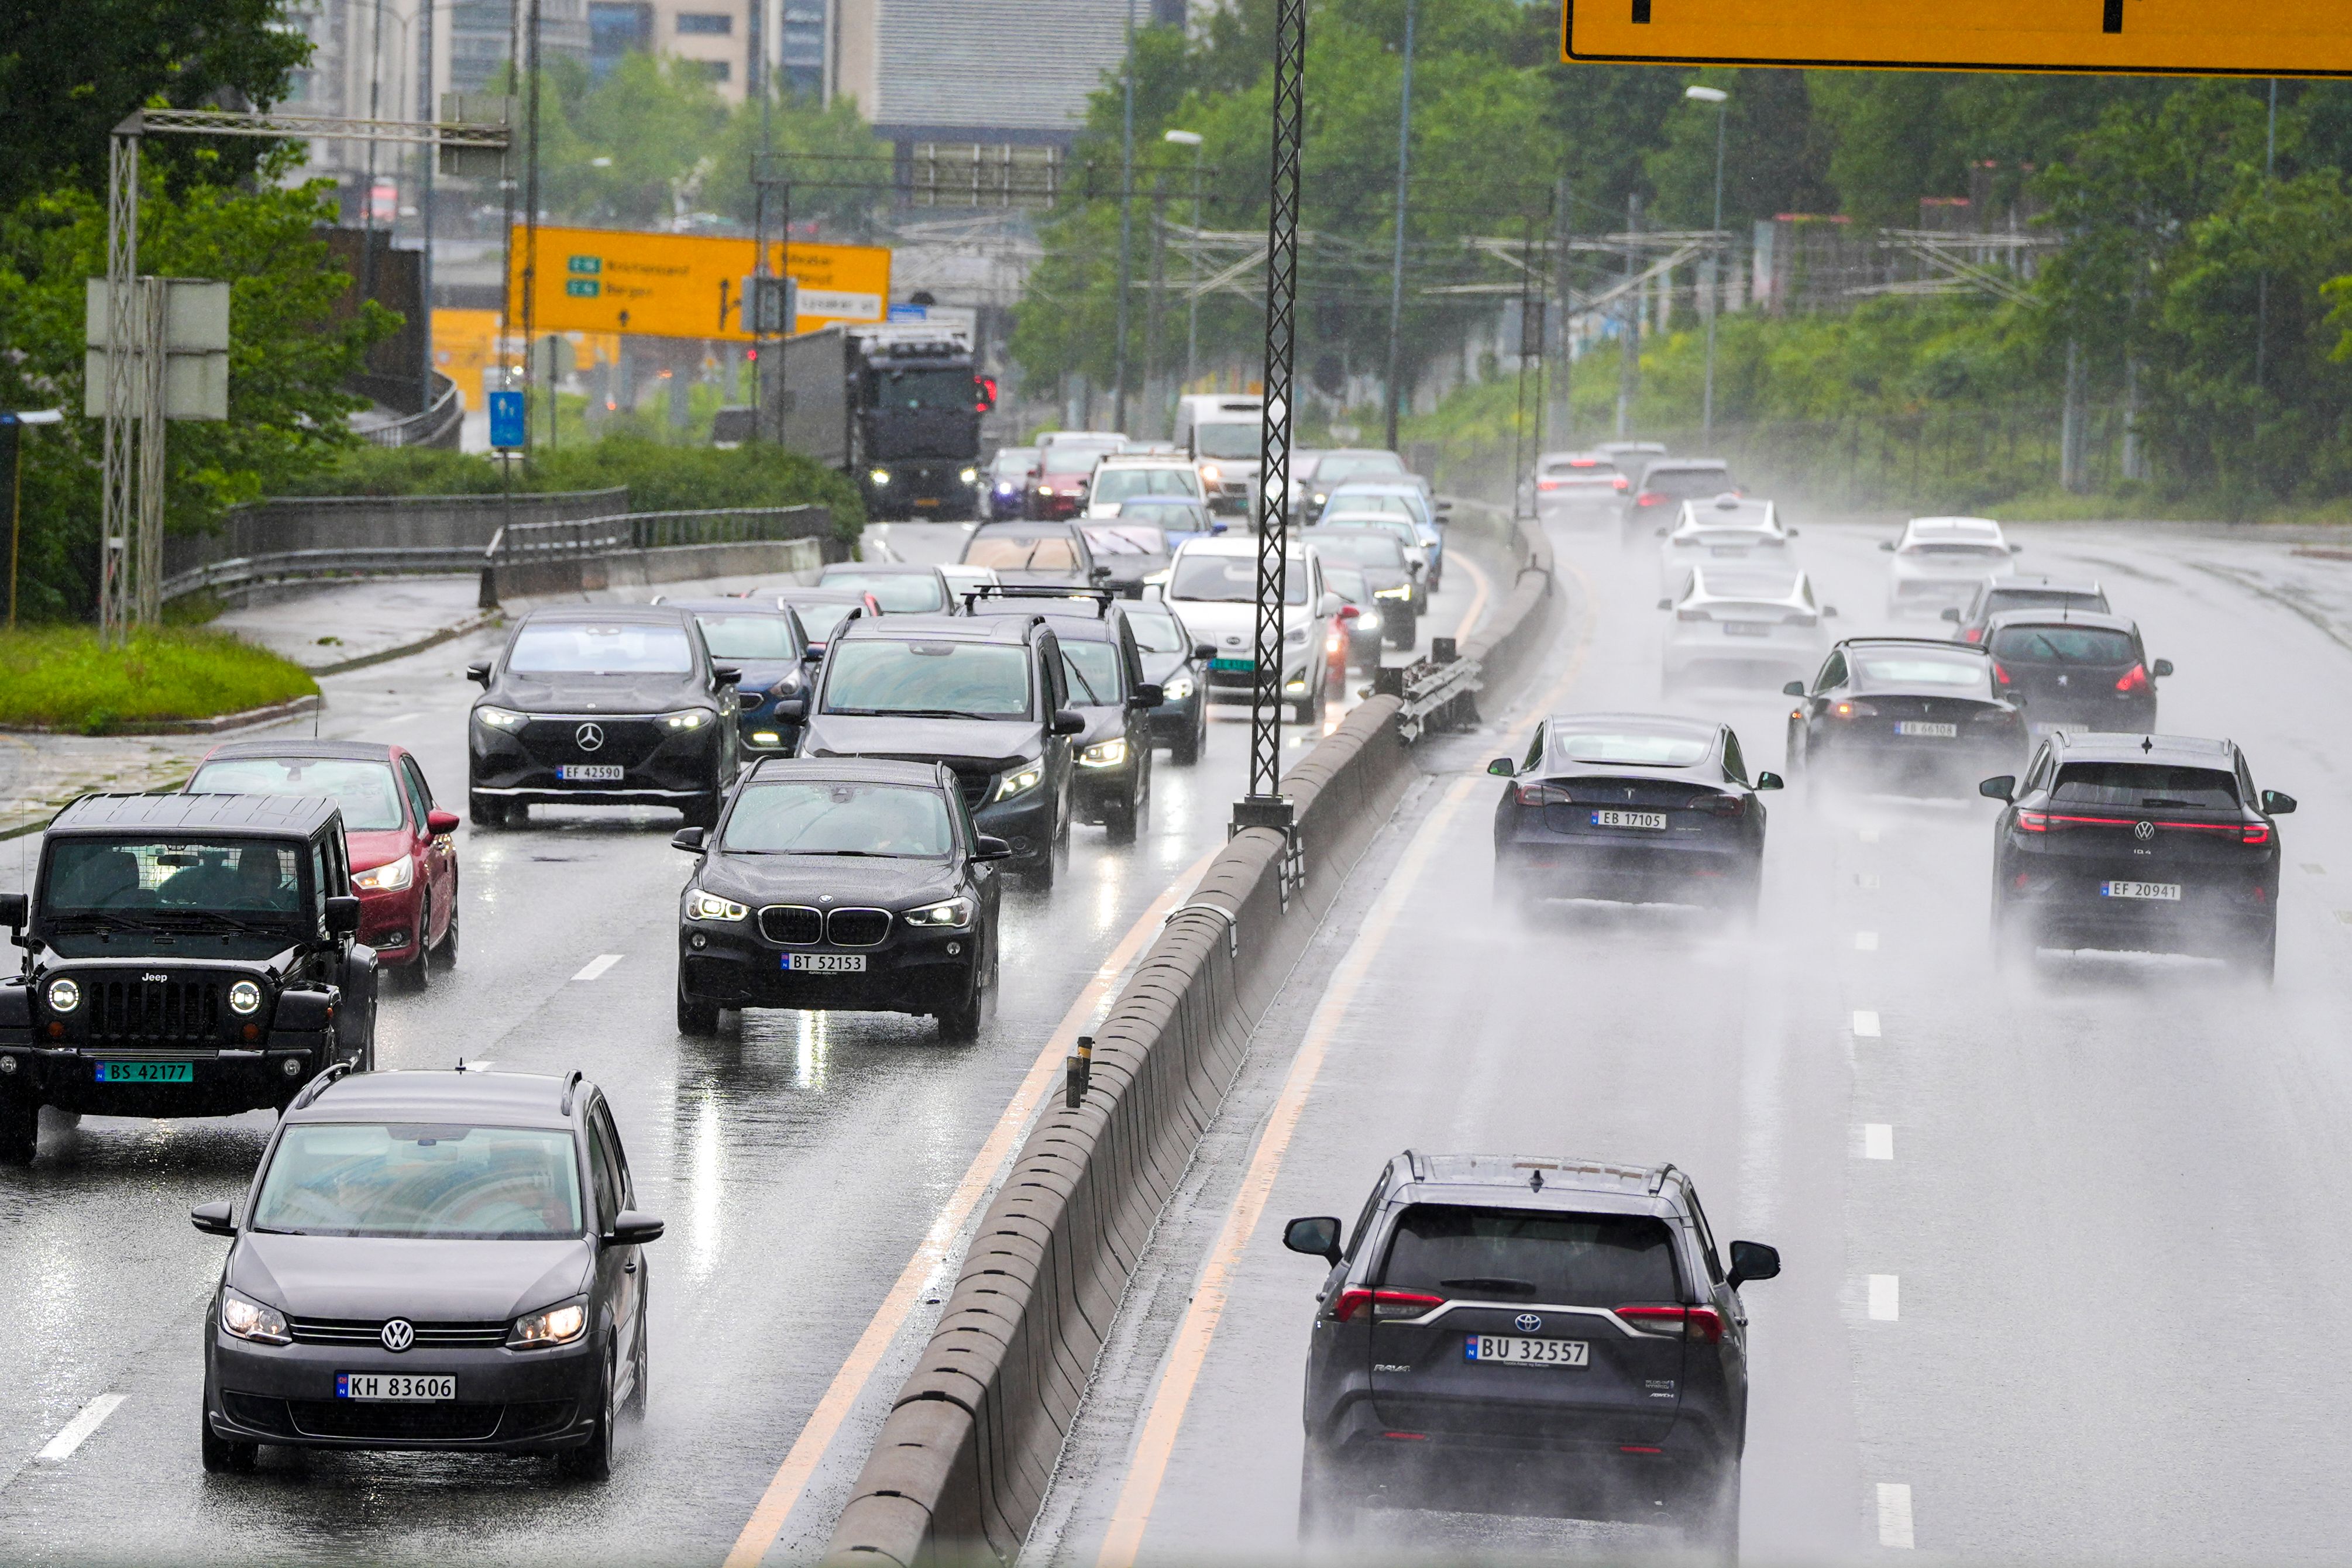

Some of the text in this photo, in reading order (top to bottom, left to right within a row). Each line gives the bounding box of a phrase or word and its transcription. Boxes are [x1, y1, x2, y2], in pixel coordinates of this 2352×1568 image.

[566, 767, 620, 778] EF 42590
[1604, 812, 1619, 824] EB
[1625, 814, 1660, 827] 17105
[2114, 883, 2129, 895] EF
[2136, 884, 2175, 898] 20941
[794, 955, 811, 969] BT
[818, 957, 861, 969] 52153
[142, 972, 168, 983] Jeep
[111, 1065, 130, 1079] BS
[138, 1065, 186, 1079] 42177
[1482, 1338, 1509, 1358] BU
[1520, 1340, 1584, 1363] 32557
[352, 1378, 378, 1396] KH
[388, 1378, 451, 1397] 83606
